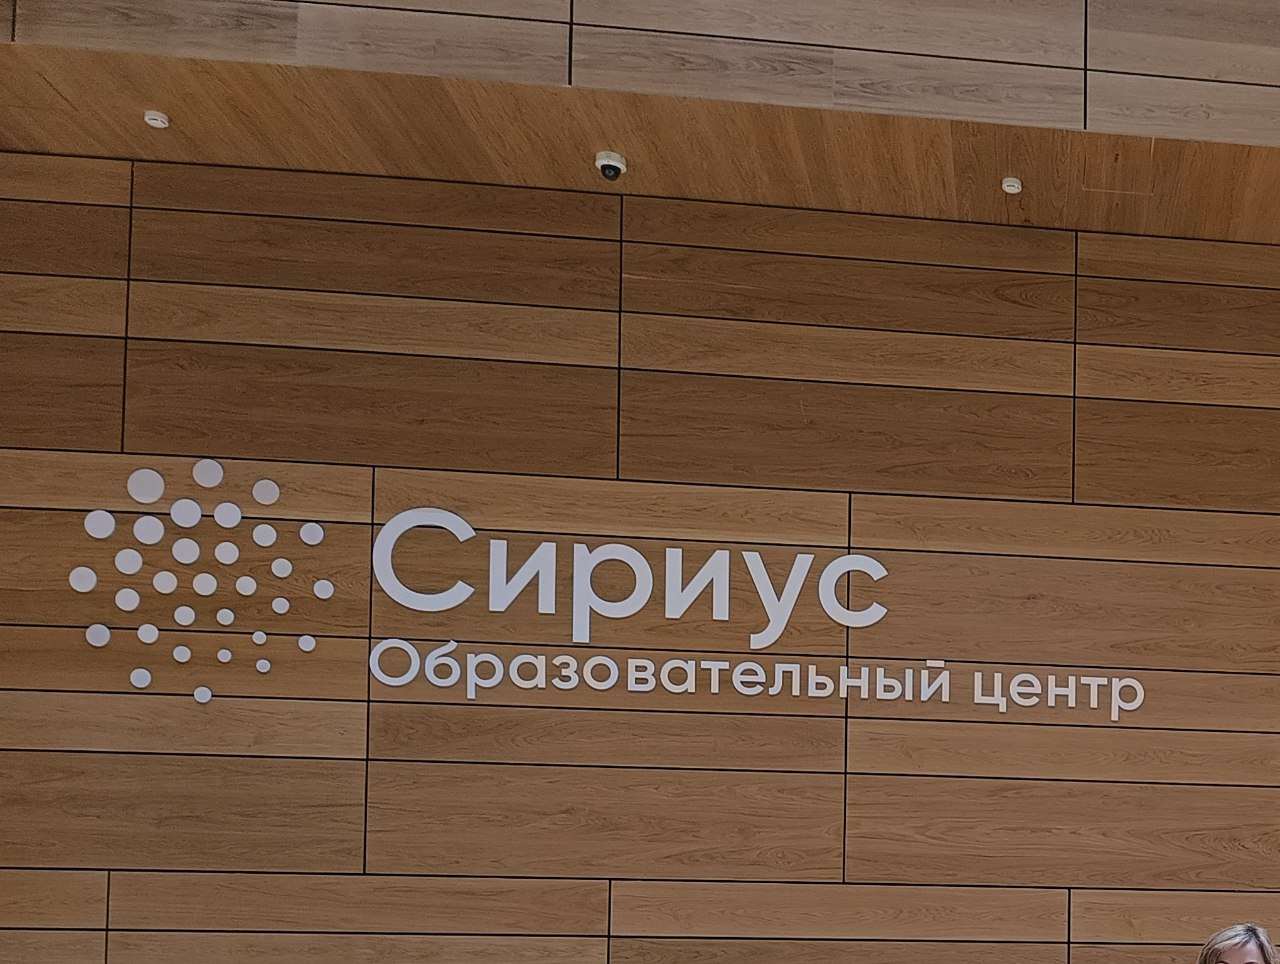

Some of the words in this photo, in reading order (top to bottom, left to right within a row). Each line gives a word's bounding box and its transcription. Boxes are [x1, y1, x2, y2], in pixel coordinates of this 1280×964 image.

[372, 507, 889, 650] Сириус
[369, 637, 950, 702] Образовательный
[973, 671, 1145, 721] центр
